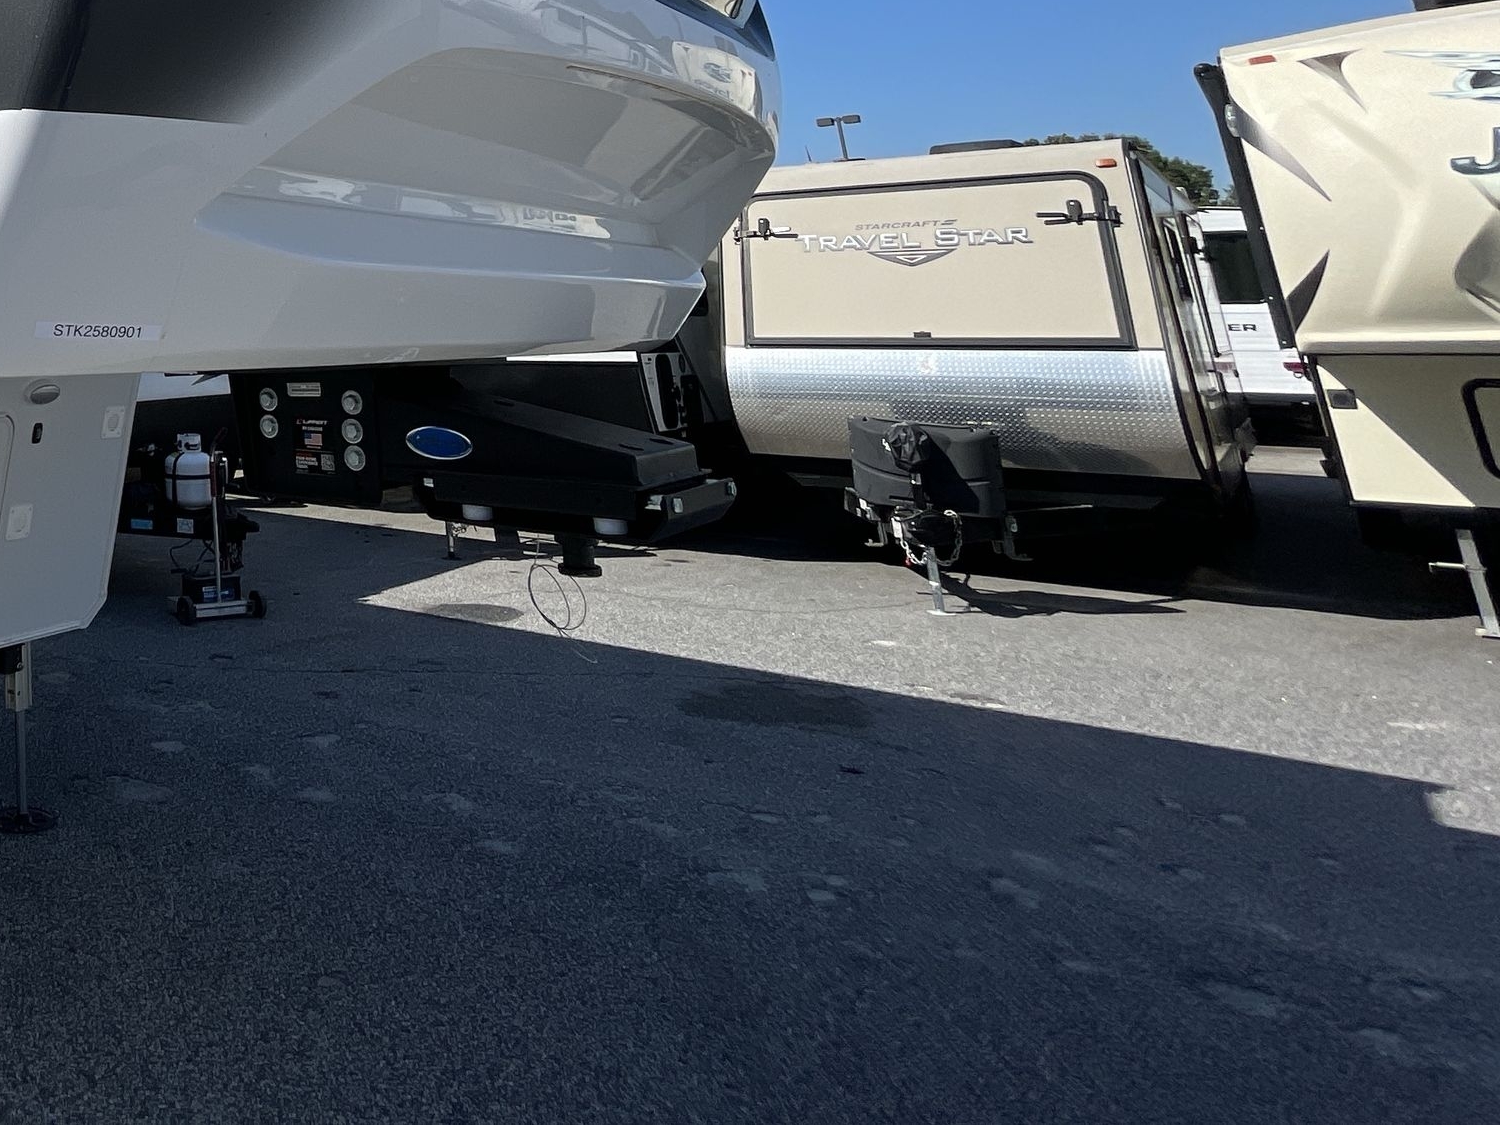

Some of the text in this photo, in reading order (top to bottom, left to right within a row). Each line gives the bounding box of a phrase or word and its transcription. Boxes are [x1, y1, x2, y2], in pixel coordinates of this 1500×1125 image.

[855, 220, 941, 231] STARCRAFT
[795, 227, 1033, 253] TRAVEL STAR
[53, 324, 143, 338] STK2580901
